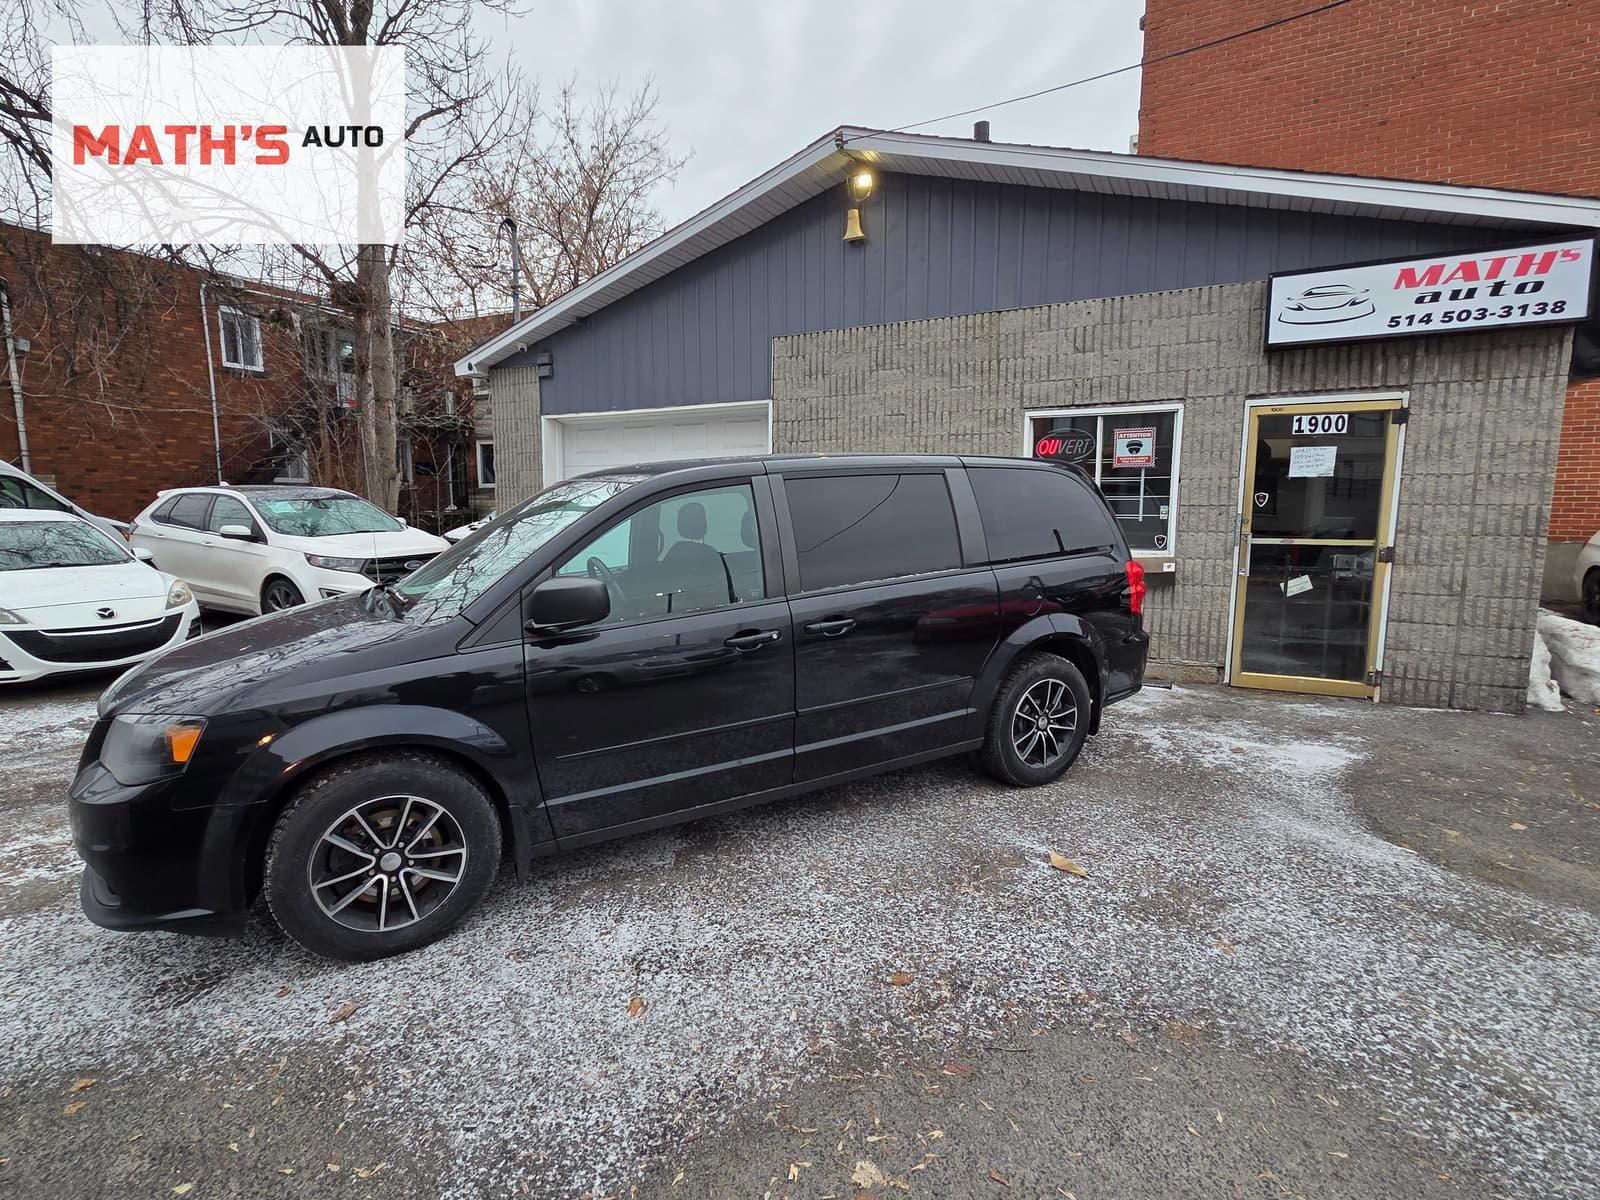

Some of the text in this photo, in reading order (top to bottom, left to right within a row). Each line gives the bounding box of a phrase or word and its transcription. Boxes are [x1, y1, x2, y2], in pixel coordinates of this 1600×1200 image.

[1414, 280, 1545, 305] auto
[1387, 300, 1568, 328] 514 503-3138
[1294, 415, 1346, 434] 1900
[1039, 439, 1092, 455] OUVERT
